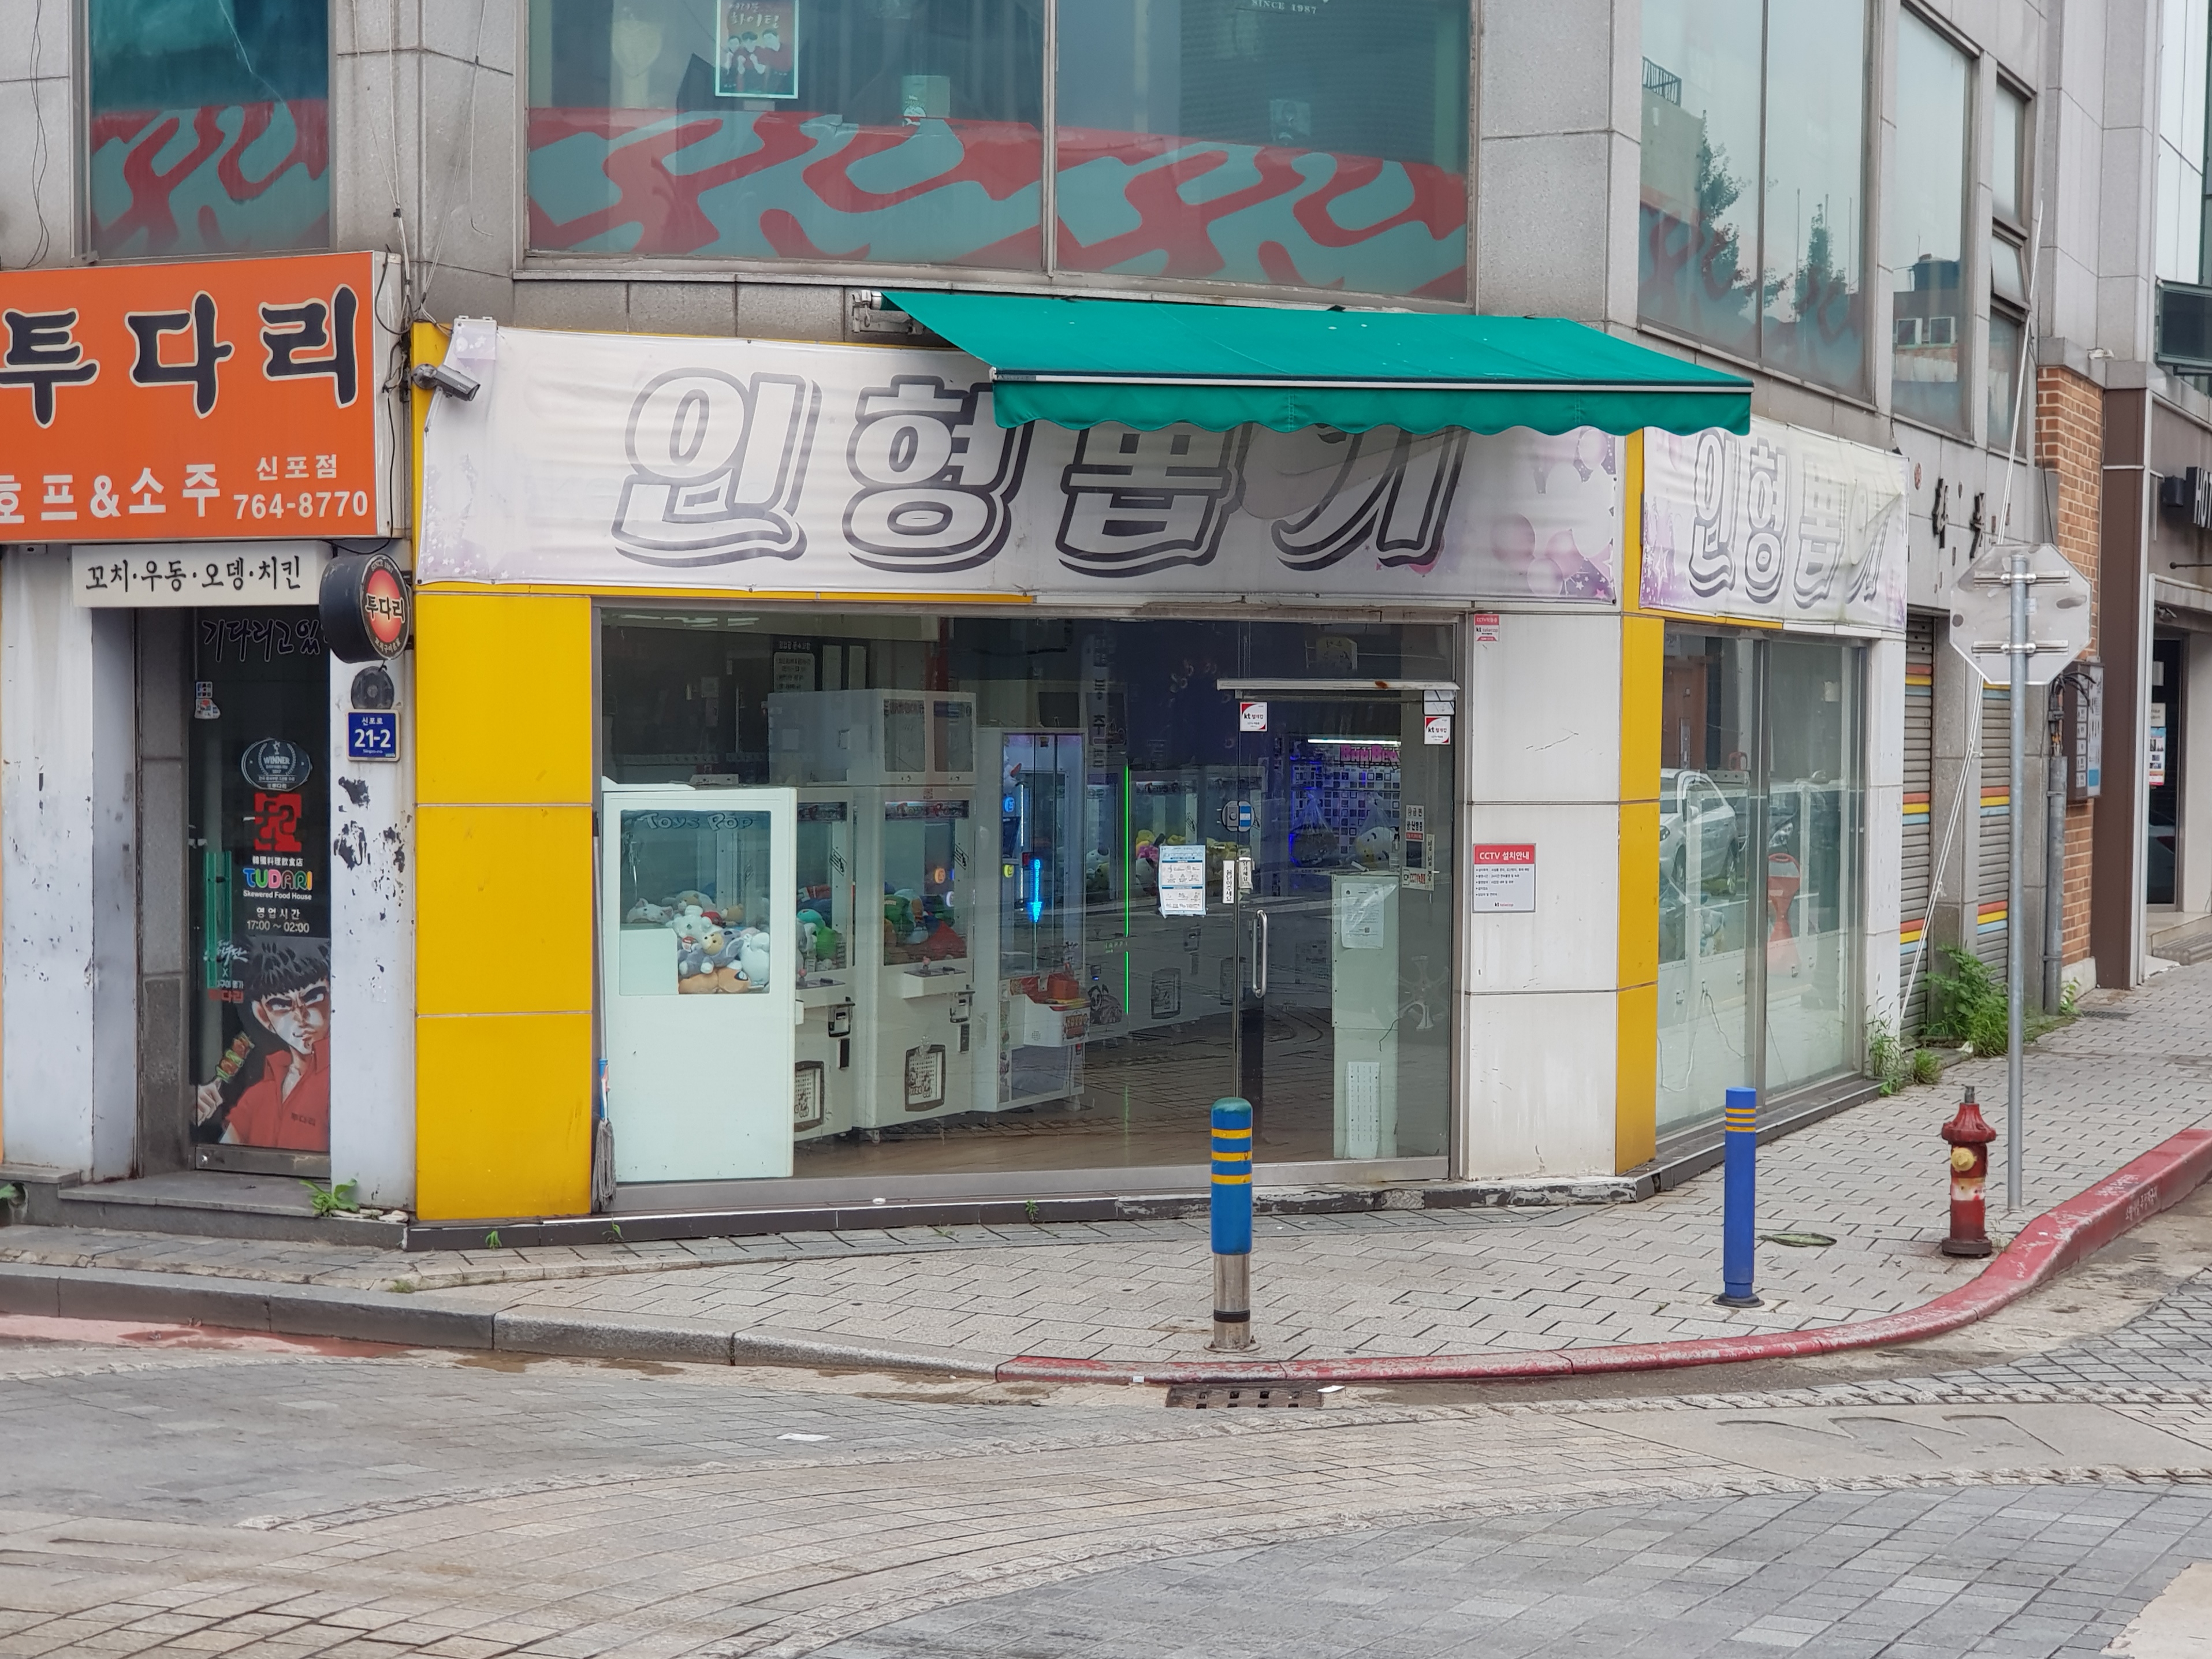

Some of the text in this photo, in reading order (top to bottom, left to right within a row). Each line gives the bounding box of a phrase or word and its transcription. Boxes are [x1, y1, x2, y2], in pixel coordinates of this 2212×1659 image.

[1291, 4, 1317, 14] 1987
[0, 283, 359, 428] 투다리
[256, 454, 338, 481] 신포점
[233, 491, 368, 520] 764-8770
[365, 593, 405, 624] 투다리
[202, 618, 328, 662] 기다리고 있
[362, 717, 383, 726] 신포로
[354, 729, 391, 748] 21-2
[263, 755, 290, 765] WINNER
[1479, 851, 1529, 860] CCTV 설치안내
[243, 868, 312, 890] TUDARI
[243, 890, 312, 901] Skewered Food House
[256, 907, 300, 920] 영업시간
[247, 920, 270, 931] 17:00
[283, 922, 310, 933] 02:00
